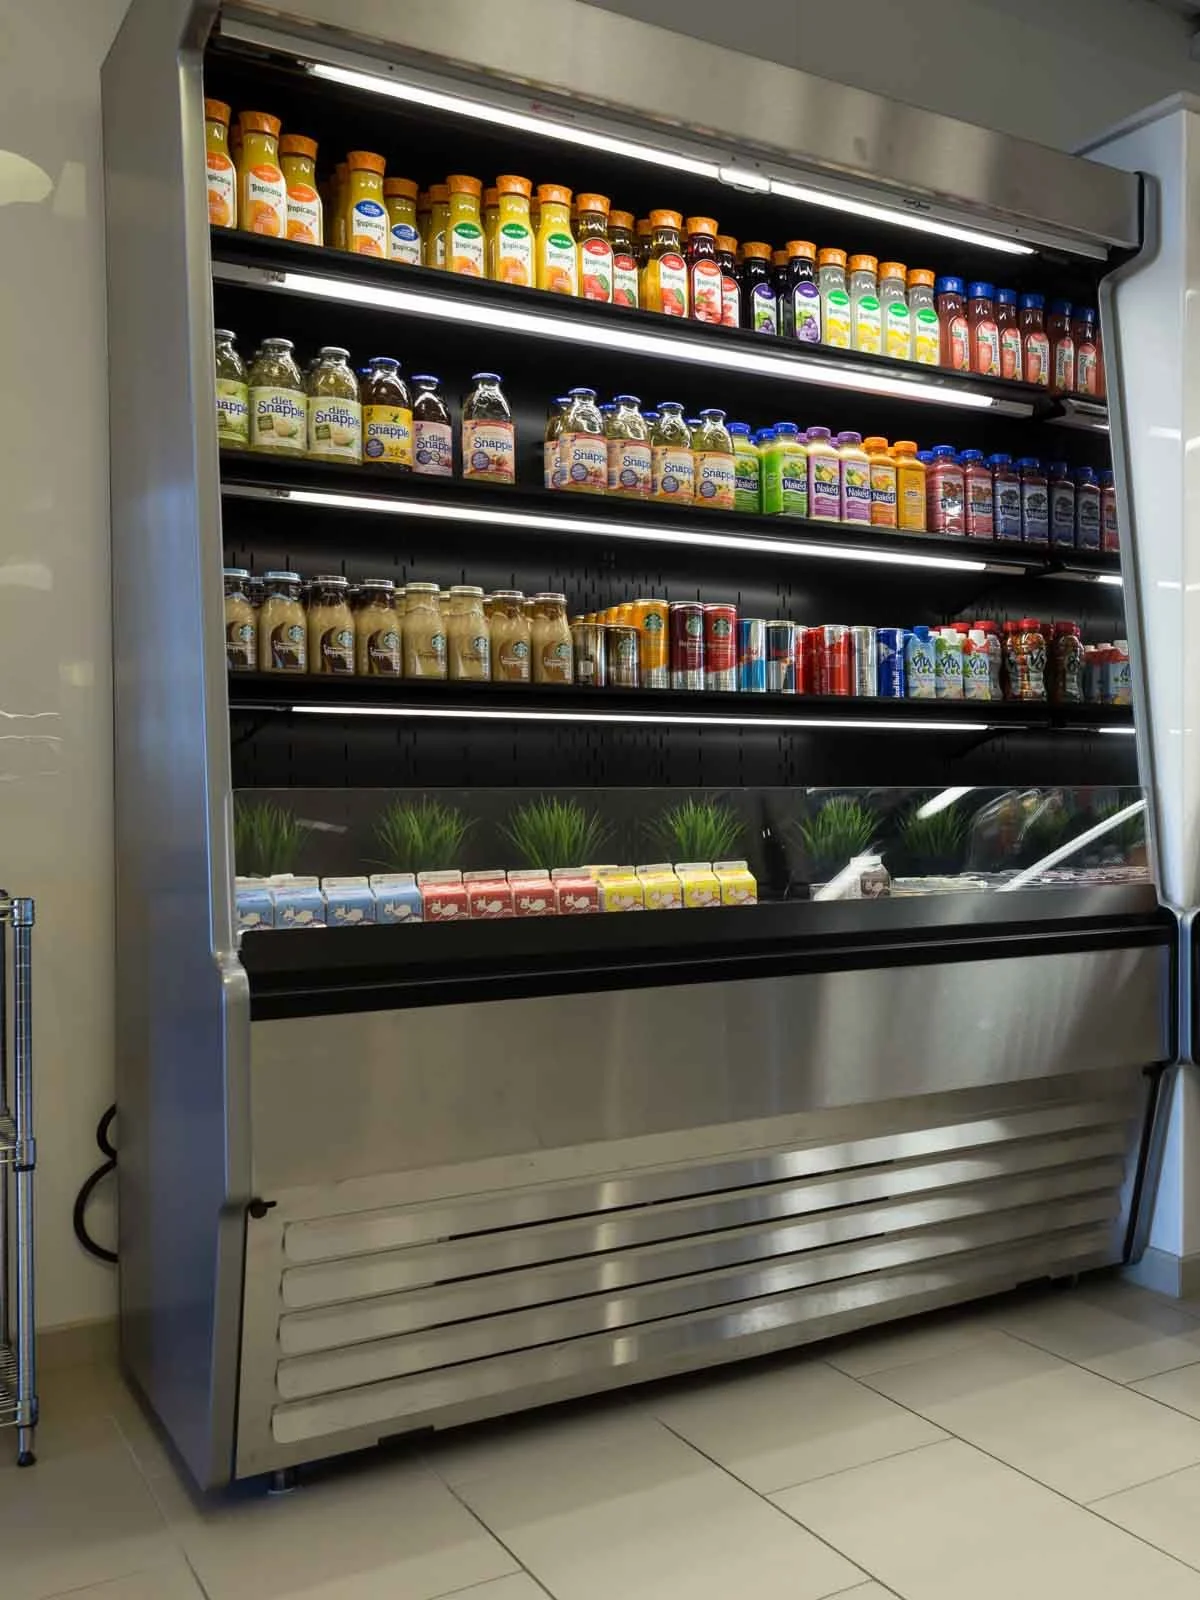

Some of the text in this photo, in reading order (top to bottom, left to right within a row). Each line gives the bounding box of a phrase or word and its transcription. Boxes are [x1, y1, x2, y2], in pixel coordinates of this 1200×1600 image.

[251, 183, 282, 197] Tropicana
[287, 203, 317, 216] Tropicana
[271, 396, 292, 405] diet
[257, 400, 304, 418] Snapple
[328, 406, 349, 415] diet
[315, 410, 360, 428] Snapple
[367, 423, 409, 440] Snapple
